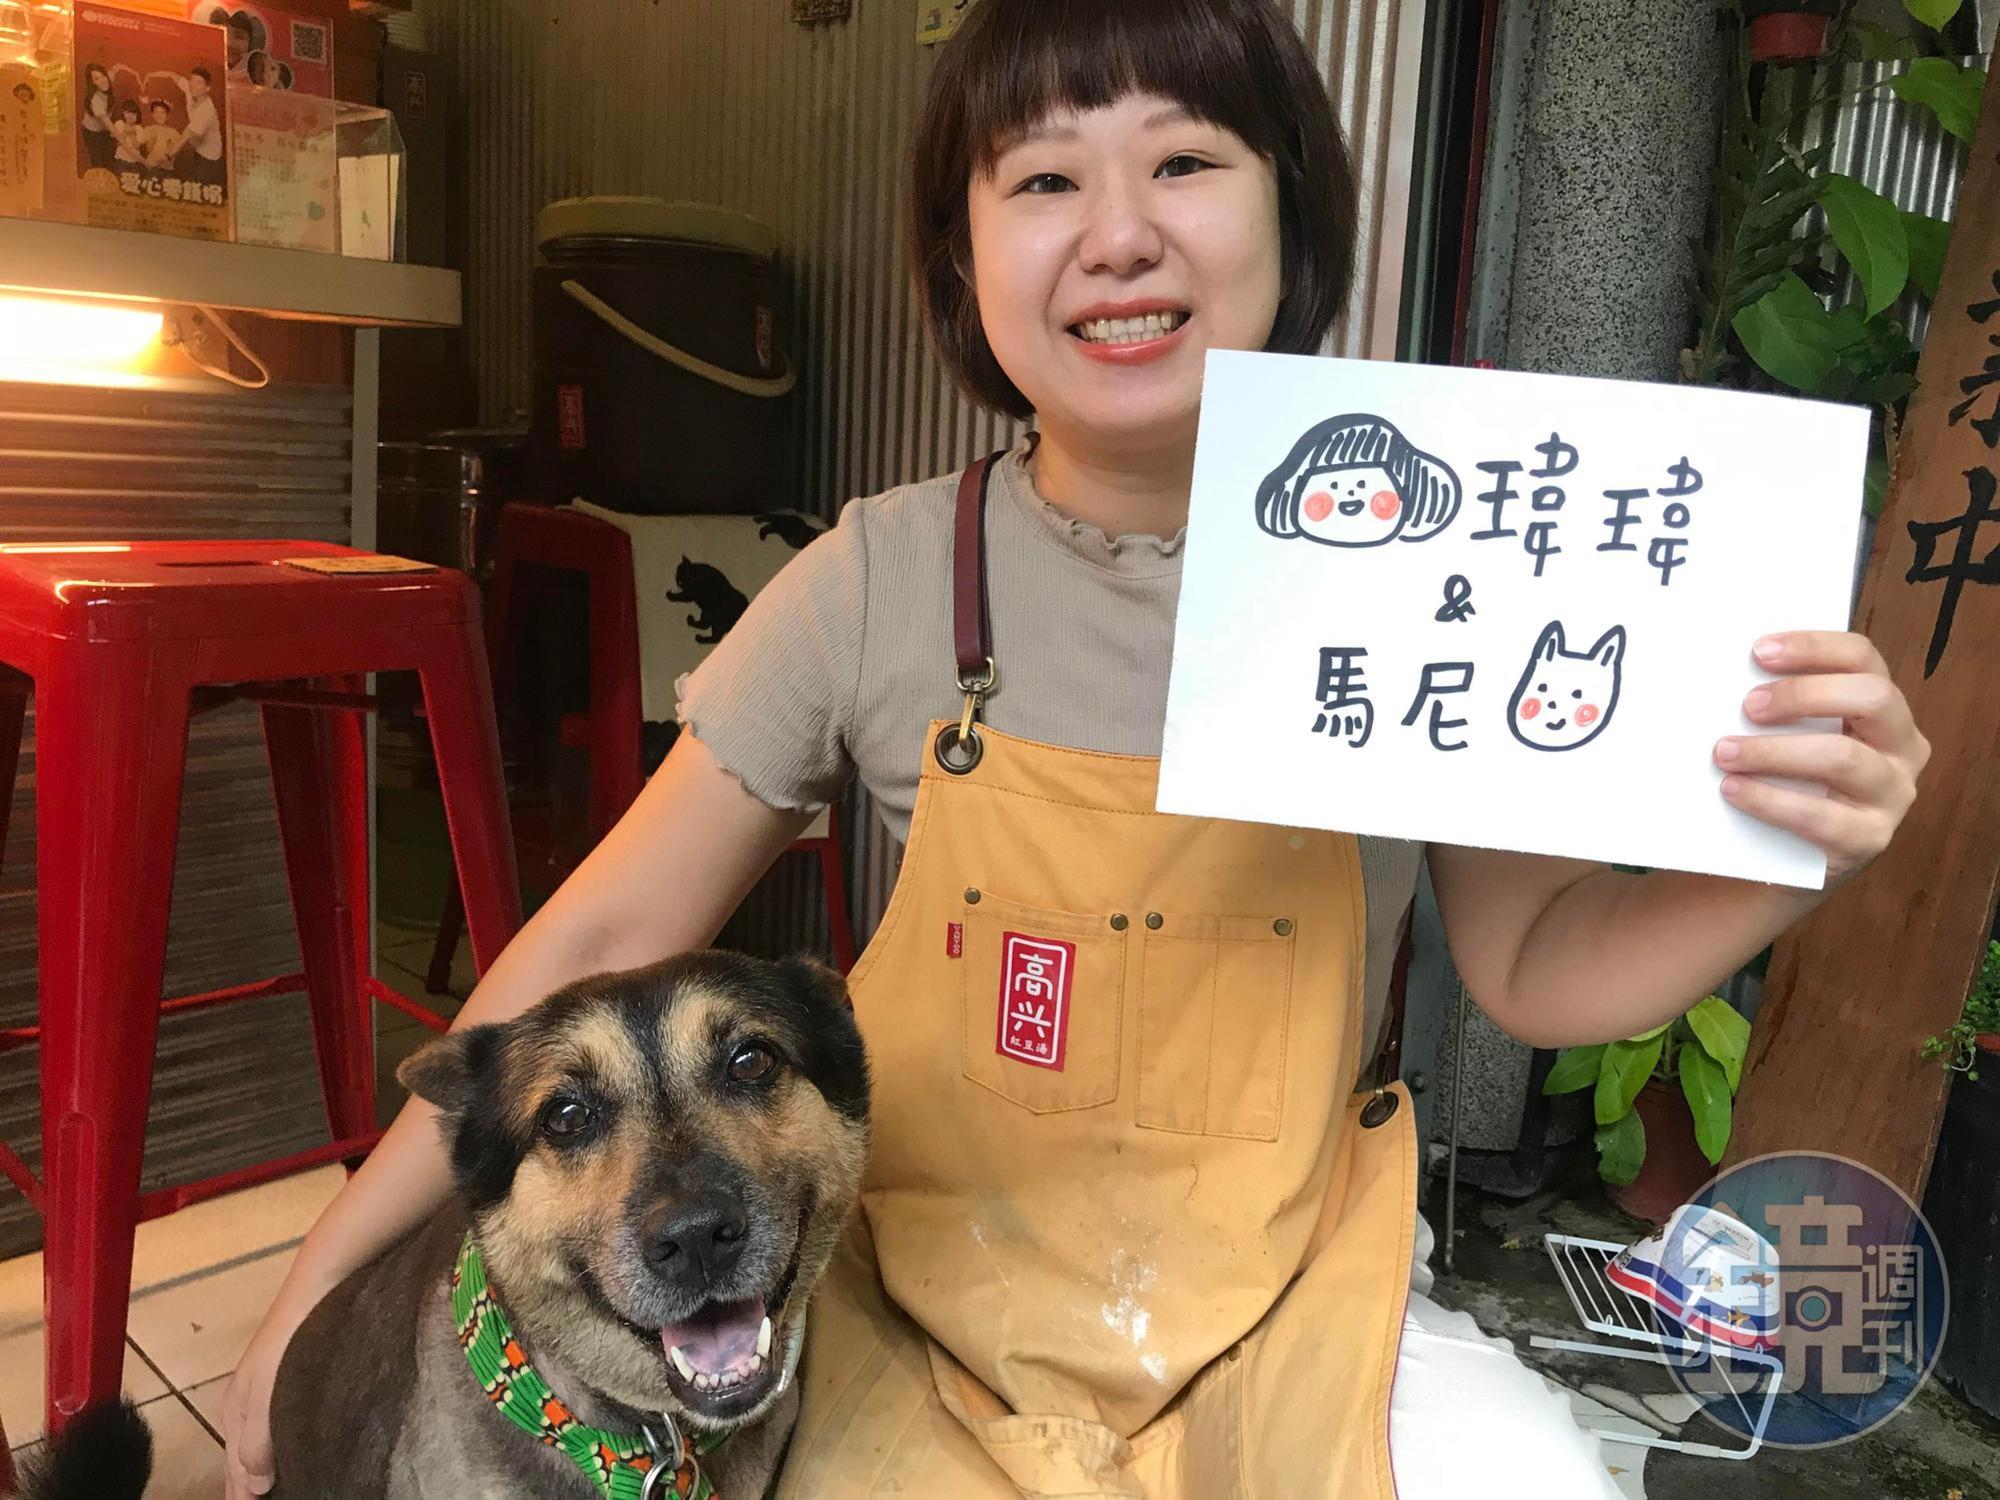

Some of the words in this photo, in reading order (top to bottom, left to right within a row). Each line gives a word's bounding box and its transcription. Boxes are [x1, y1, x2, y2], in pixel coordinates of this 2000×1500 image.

[1435, 575, 1475, 622] &
[1312, 647, 1474, 750] 馬尼
[1011, 954, 1053, 1038] 高兴
